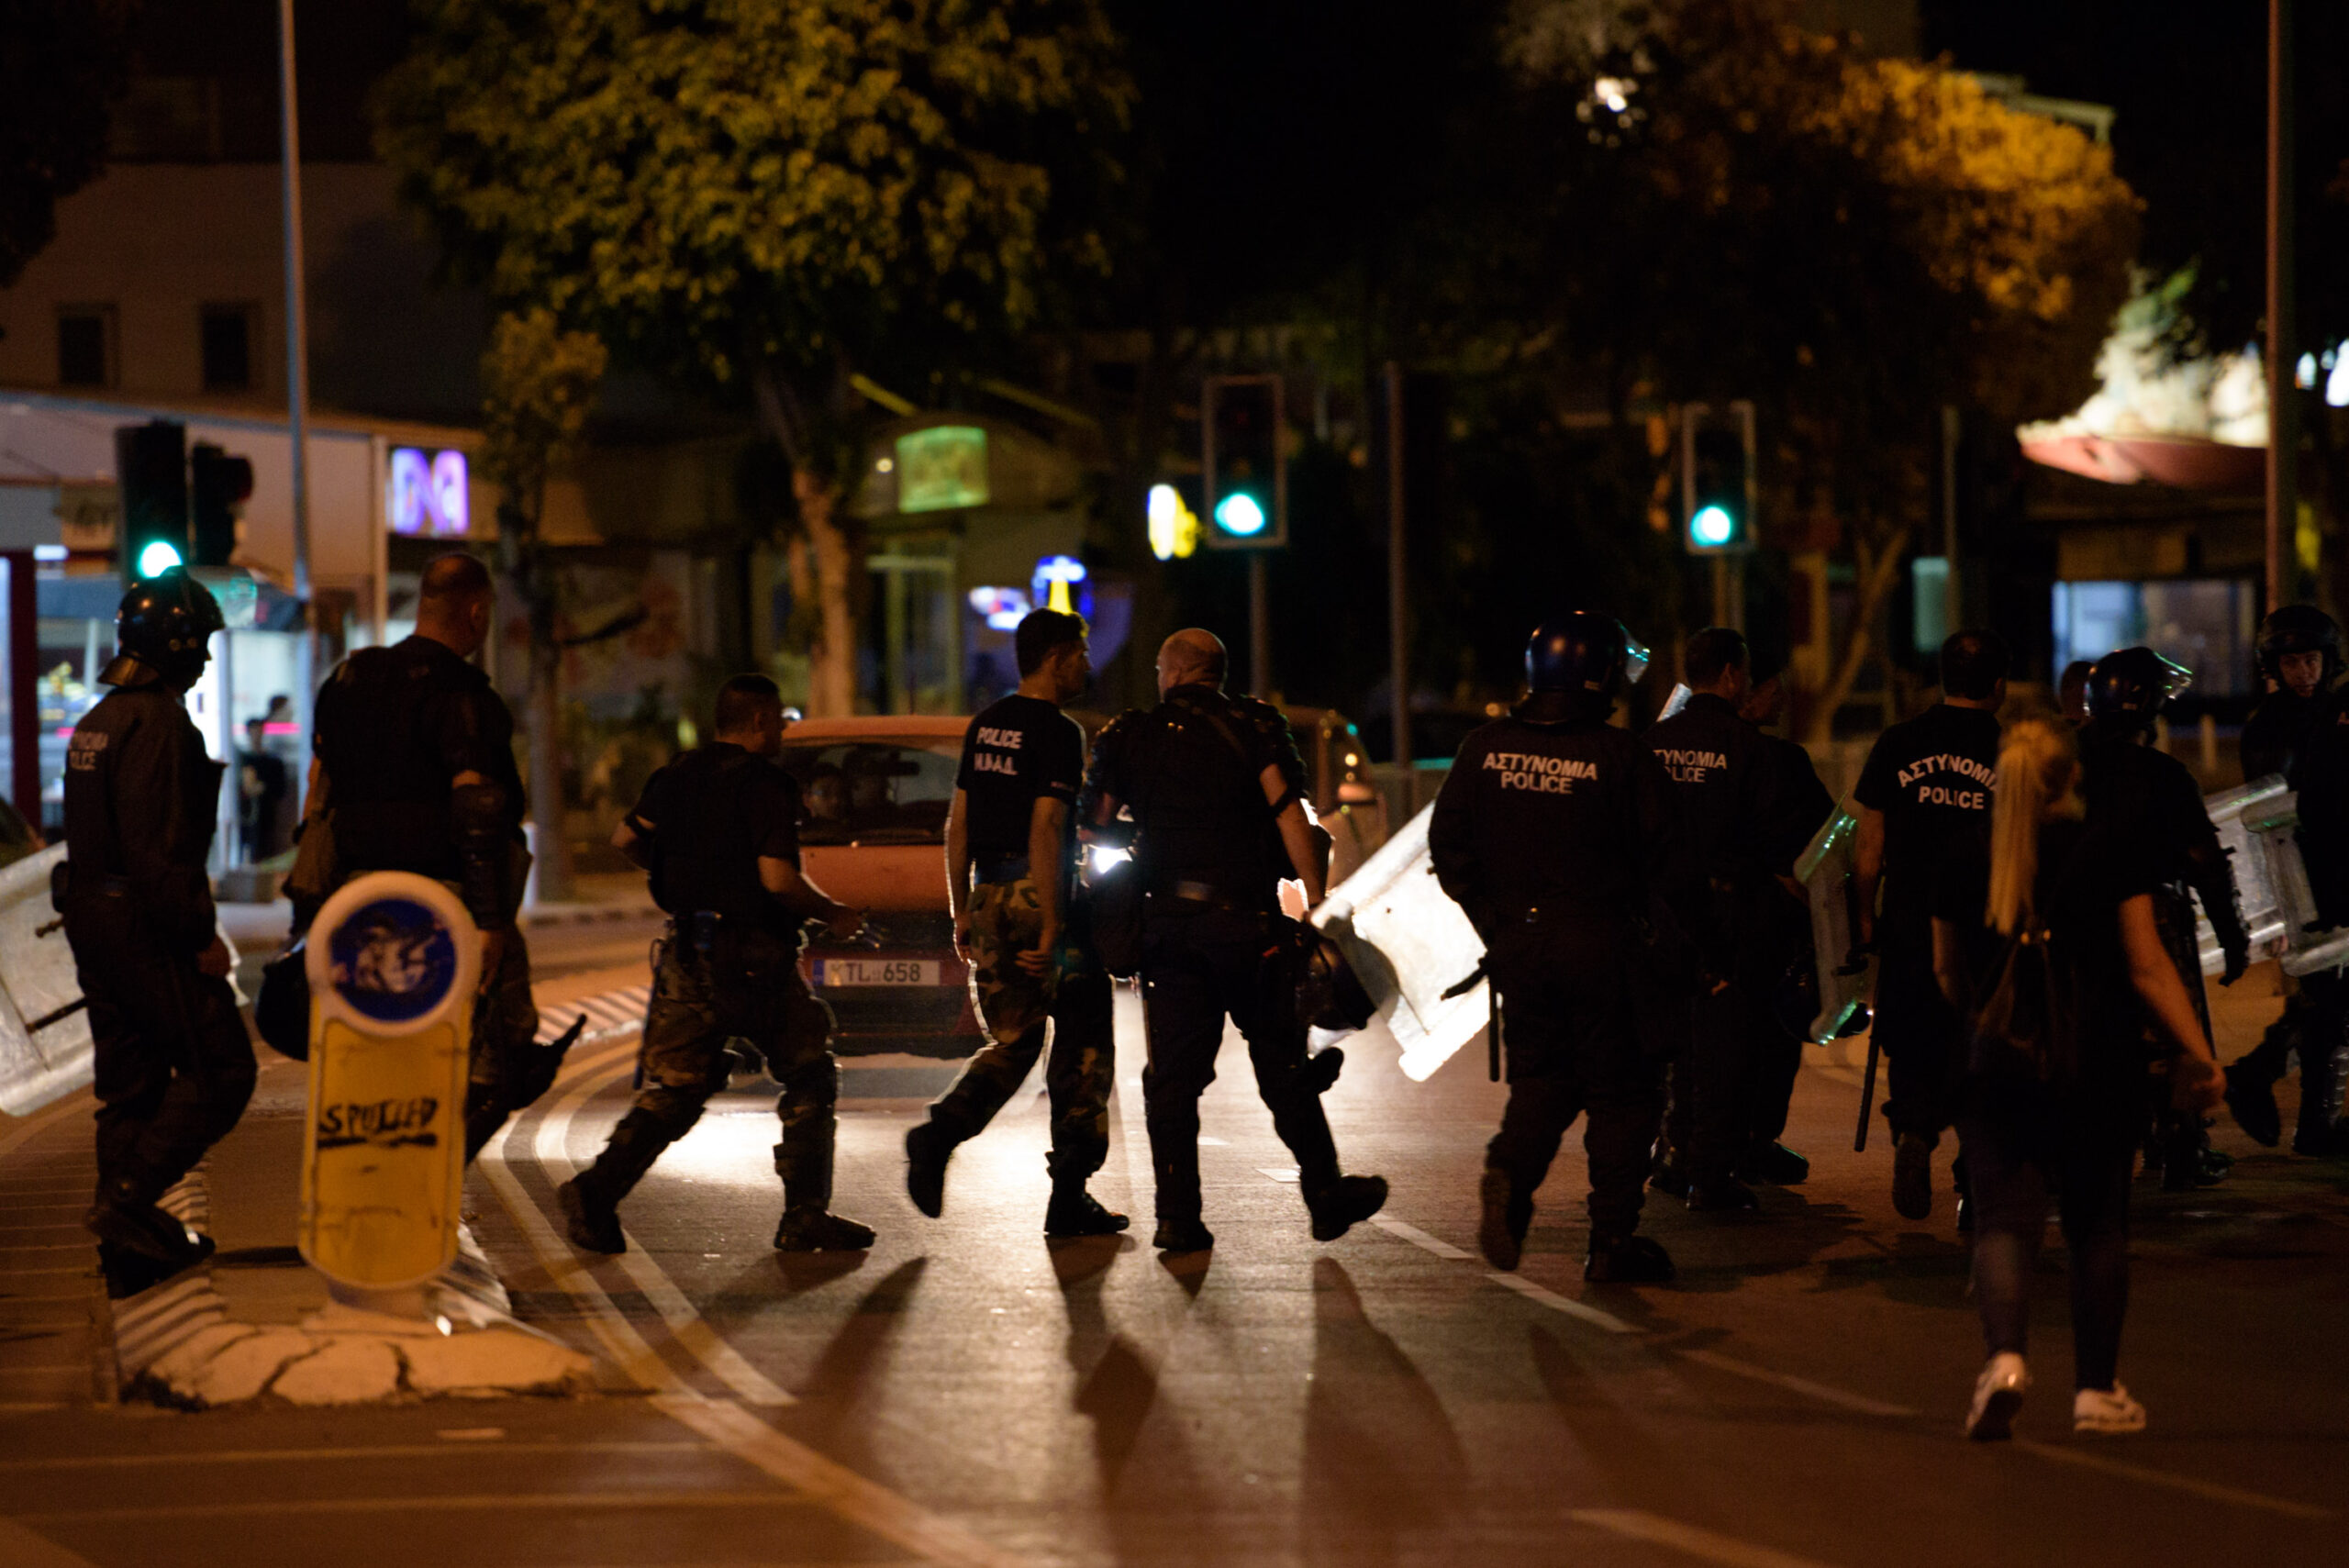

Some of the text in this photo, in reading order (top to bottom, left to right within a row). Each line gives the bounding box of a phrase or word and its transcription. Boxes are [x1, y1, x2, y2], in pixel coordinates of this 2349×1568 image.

[975, 726, 1024, 750] POLICE
[1482, 751, 1598, 781] ΑΣΤΥΝΟΜΙΑ
[1653, 749, 1728, 770] ΤΥΝΟΜΙΑ
[1500, 771, 1574, 795] POLICE
[1664, 765, 1707, 784] LICE
[1917, 785, 1985, 810] POLICE
[884, 963, 921, 983] 658
